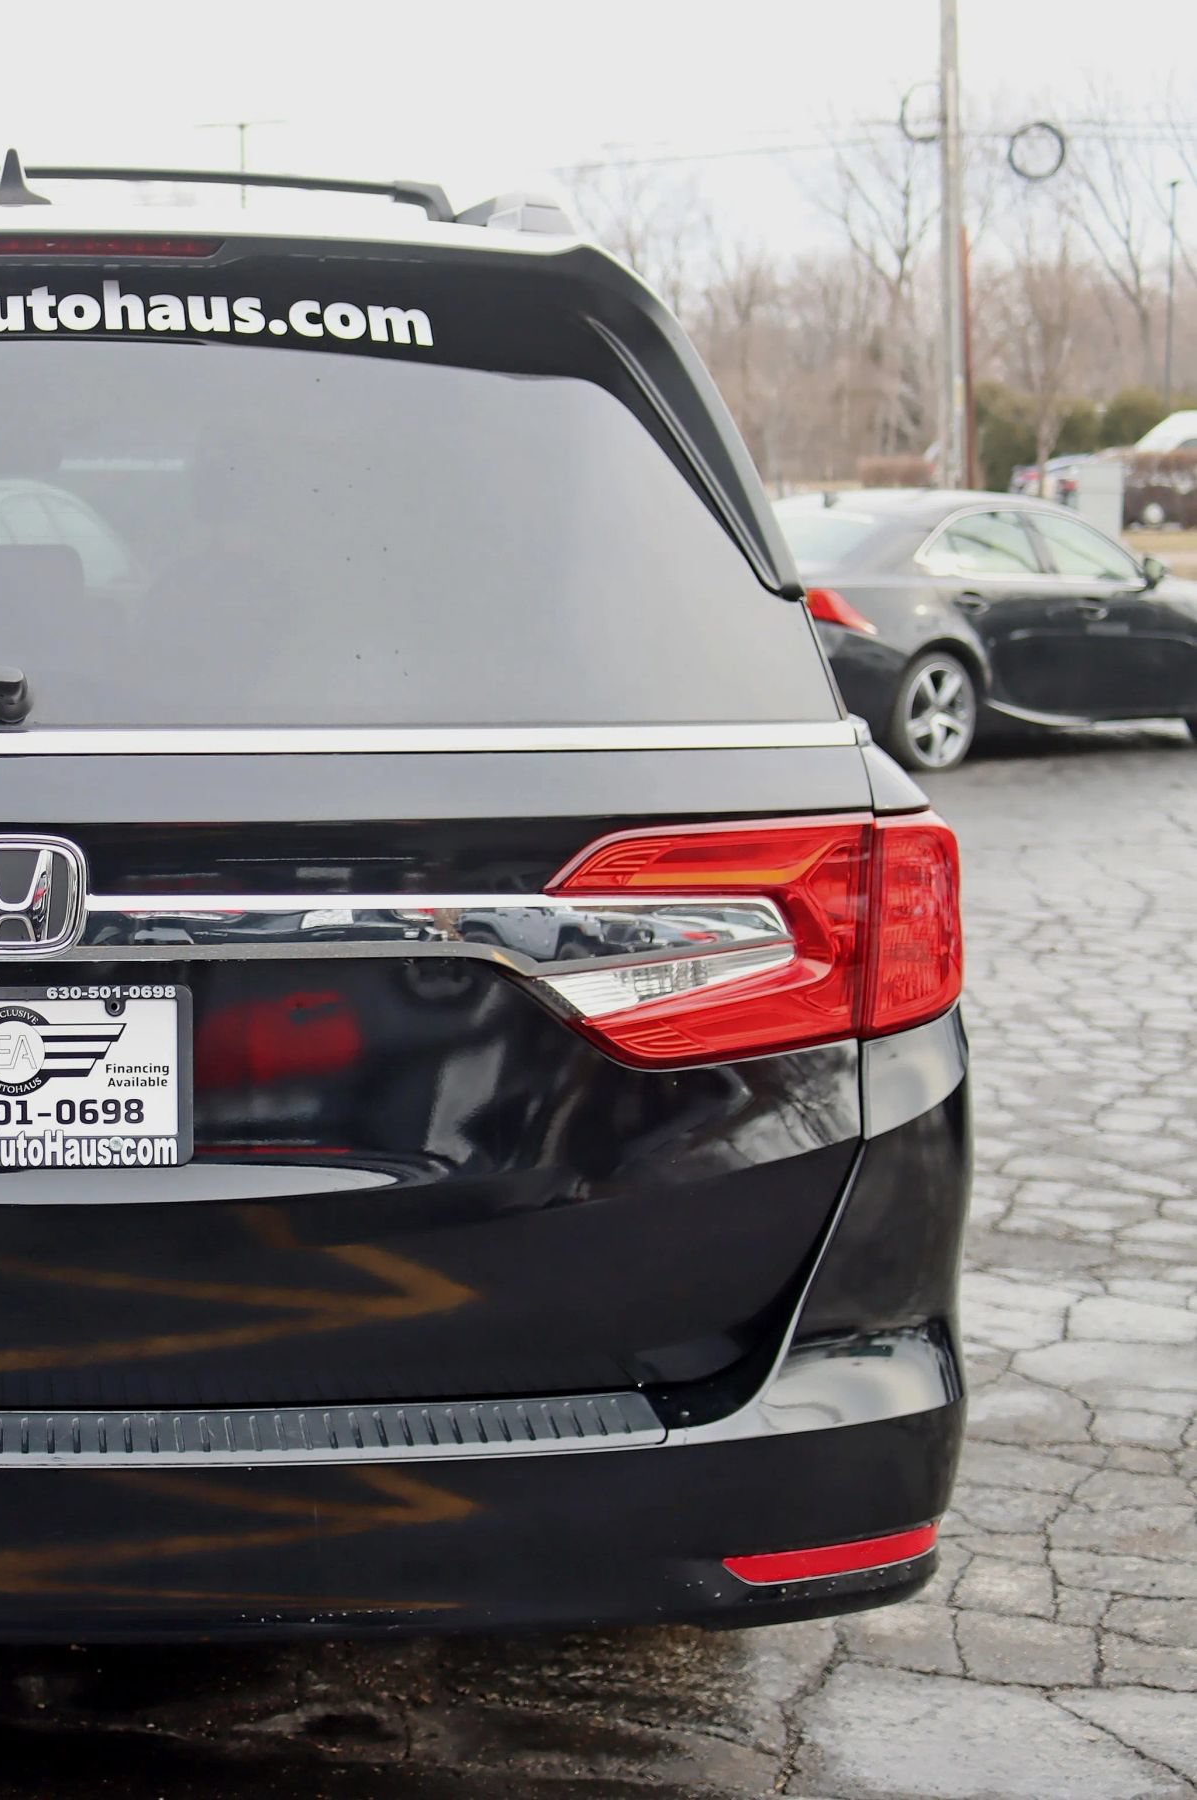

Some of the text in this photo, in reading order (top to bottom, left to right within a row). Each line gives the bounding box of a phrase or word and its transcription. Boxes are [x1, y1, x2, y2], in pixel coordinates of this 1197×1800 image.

[46, 986, 176, 999] 630-501-0698
[105, 1063, 170, 1075] Financing
[107, 1077, 168, 1087] Available
